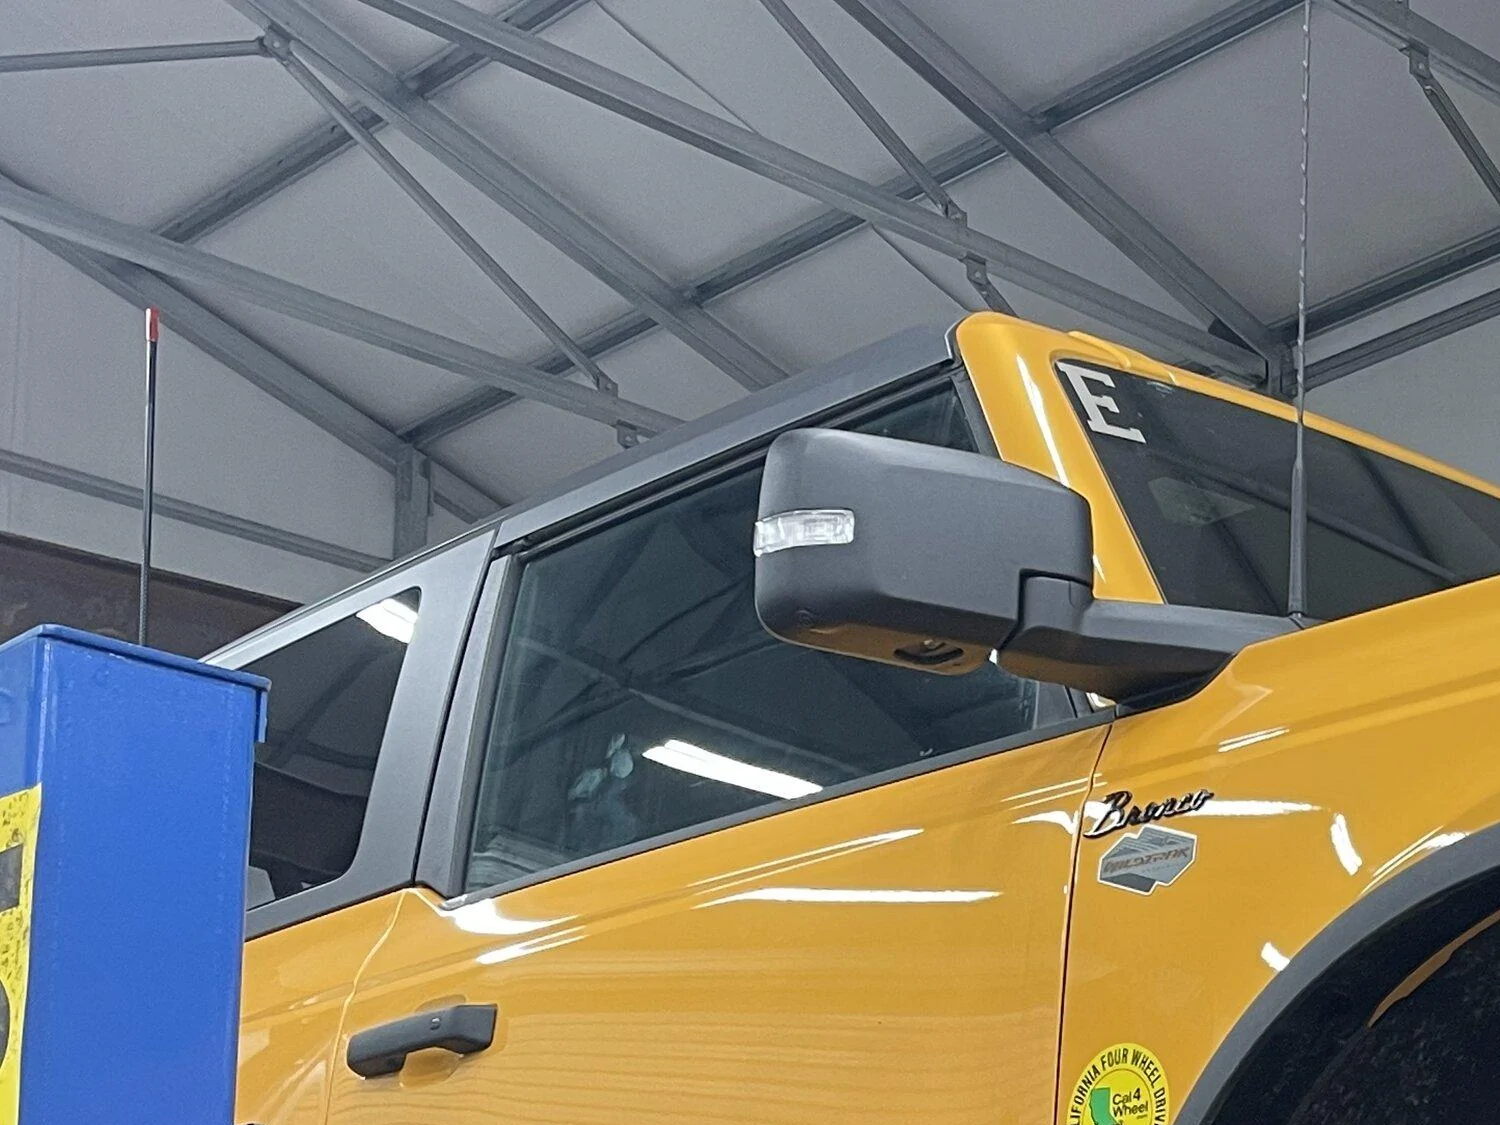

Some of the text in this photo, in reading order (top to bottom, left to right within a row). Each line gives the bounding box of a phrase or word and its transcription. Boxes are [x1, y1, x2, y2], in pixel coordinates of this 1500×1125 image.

[1056, 361, 1147, 444] E
[1083, 790, 1215, 839] Bronco
[1100, 1048, 1129, 1071] FOUR
[1131, 1049, 1162, 1089] WHEEL
[1113, 1101, 1149, 1117] Wheel
